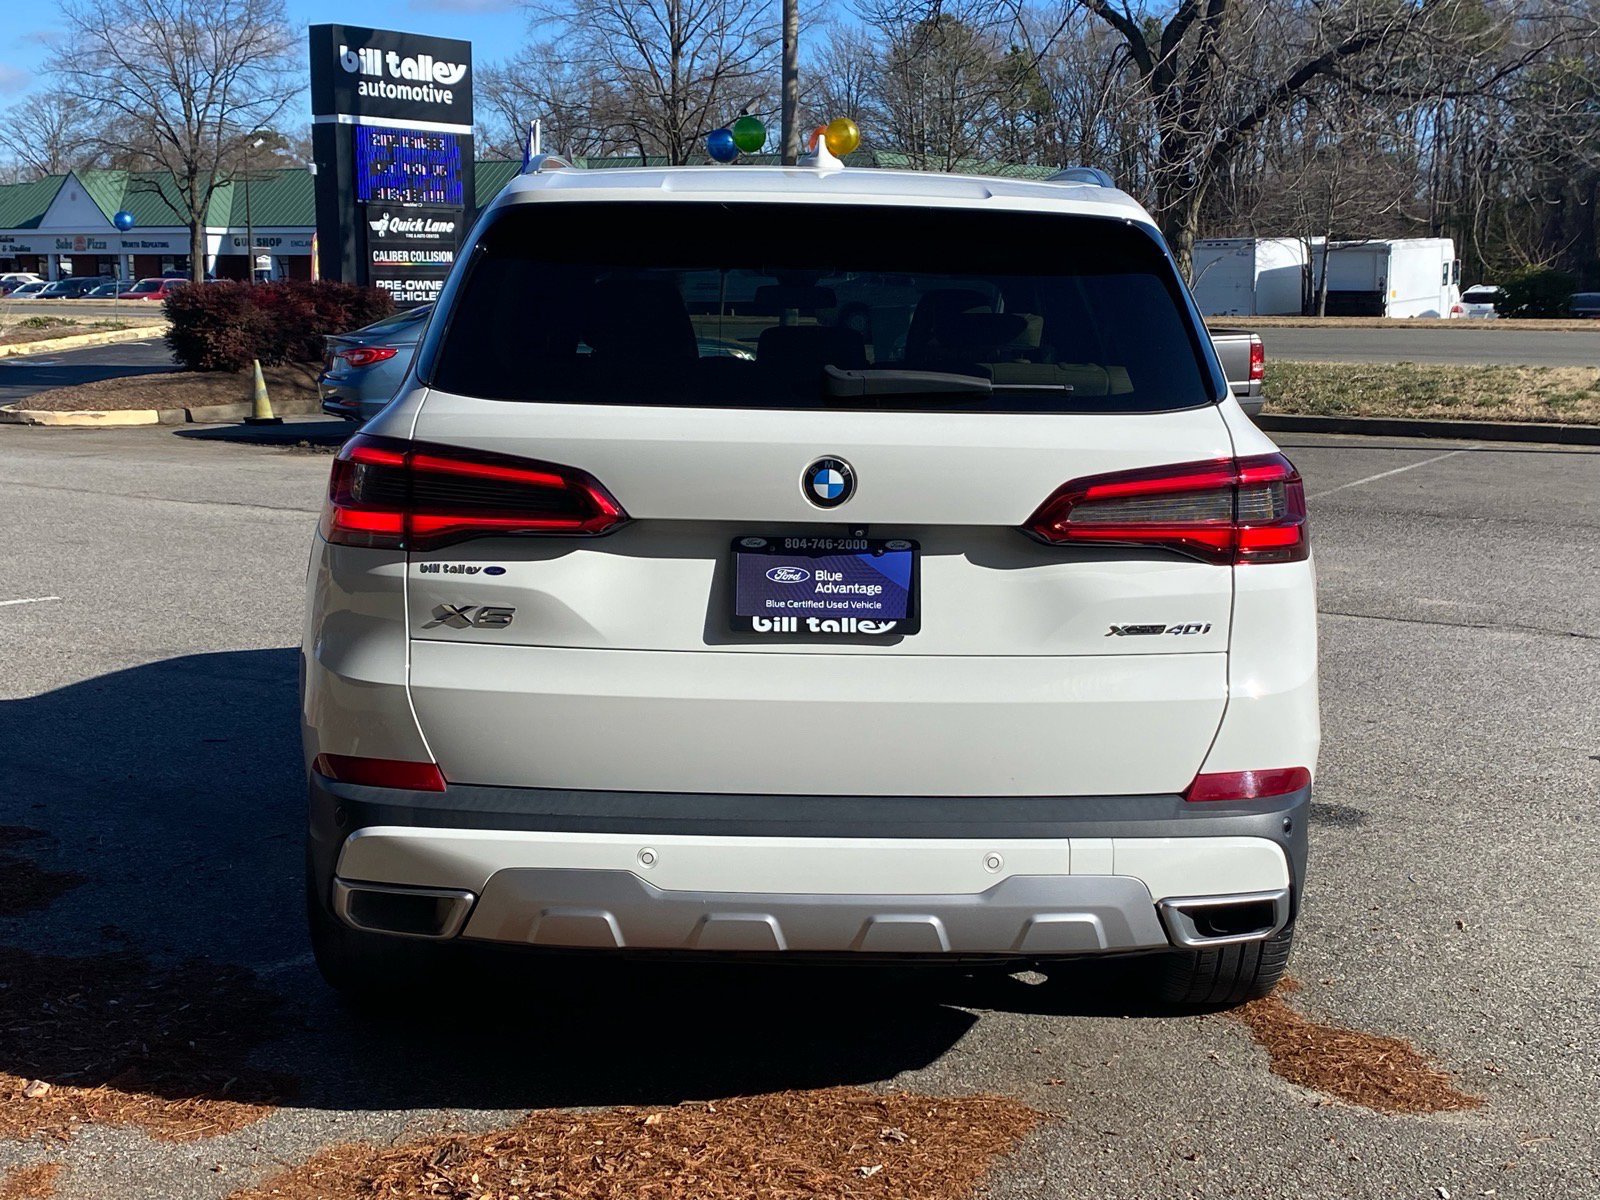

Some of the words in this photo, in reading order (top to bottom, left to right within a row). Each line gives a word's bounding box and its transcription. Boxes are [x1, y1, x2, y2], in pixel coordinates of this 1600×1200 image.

[339, 45, 382, 76] bill
[386, 51, 467, 85] talley
[358, 81, 453, 104] automotive
[389, 217, 424, 233] Quick
[424, 218, 455, 233] Lane
[55, 238, 73, 250] Subs
[86, 238, 107, 250] Pizza
[234, 237, 249, 247] GU
[256, 237, 282, 247] SHOP
[373, 250, 409, 262] CALIBER
[410, 250, 453, 262] COLLISION
[375, 280, 443, 290] PRE-OWNE
[389, 291, 439, 301] EHICLE
[784, 538, 868, 550] 804-746-2000
[420, 564, 441, 573] bill
[442, 564, 482, 575] talley
[774, 569, 802, 581] Ford
[815, 570, 843, 582] Blue
[814, 583, 883, 596] Advantage
[765, 600, 785, 608] Blue
[787, 600, 825, 609] Certified
[826, 601, 849, 609] Used
[851, 601, 882, 610] Vehicle
[752, 616, 797, 633] bill
[806, 616, 897, 634] talley
